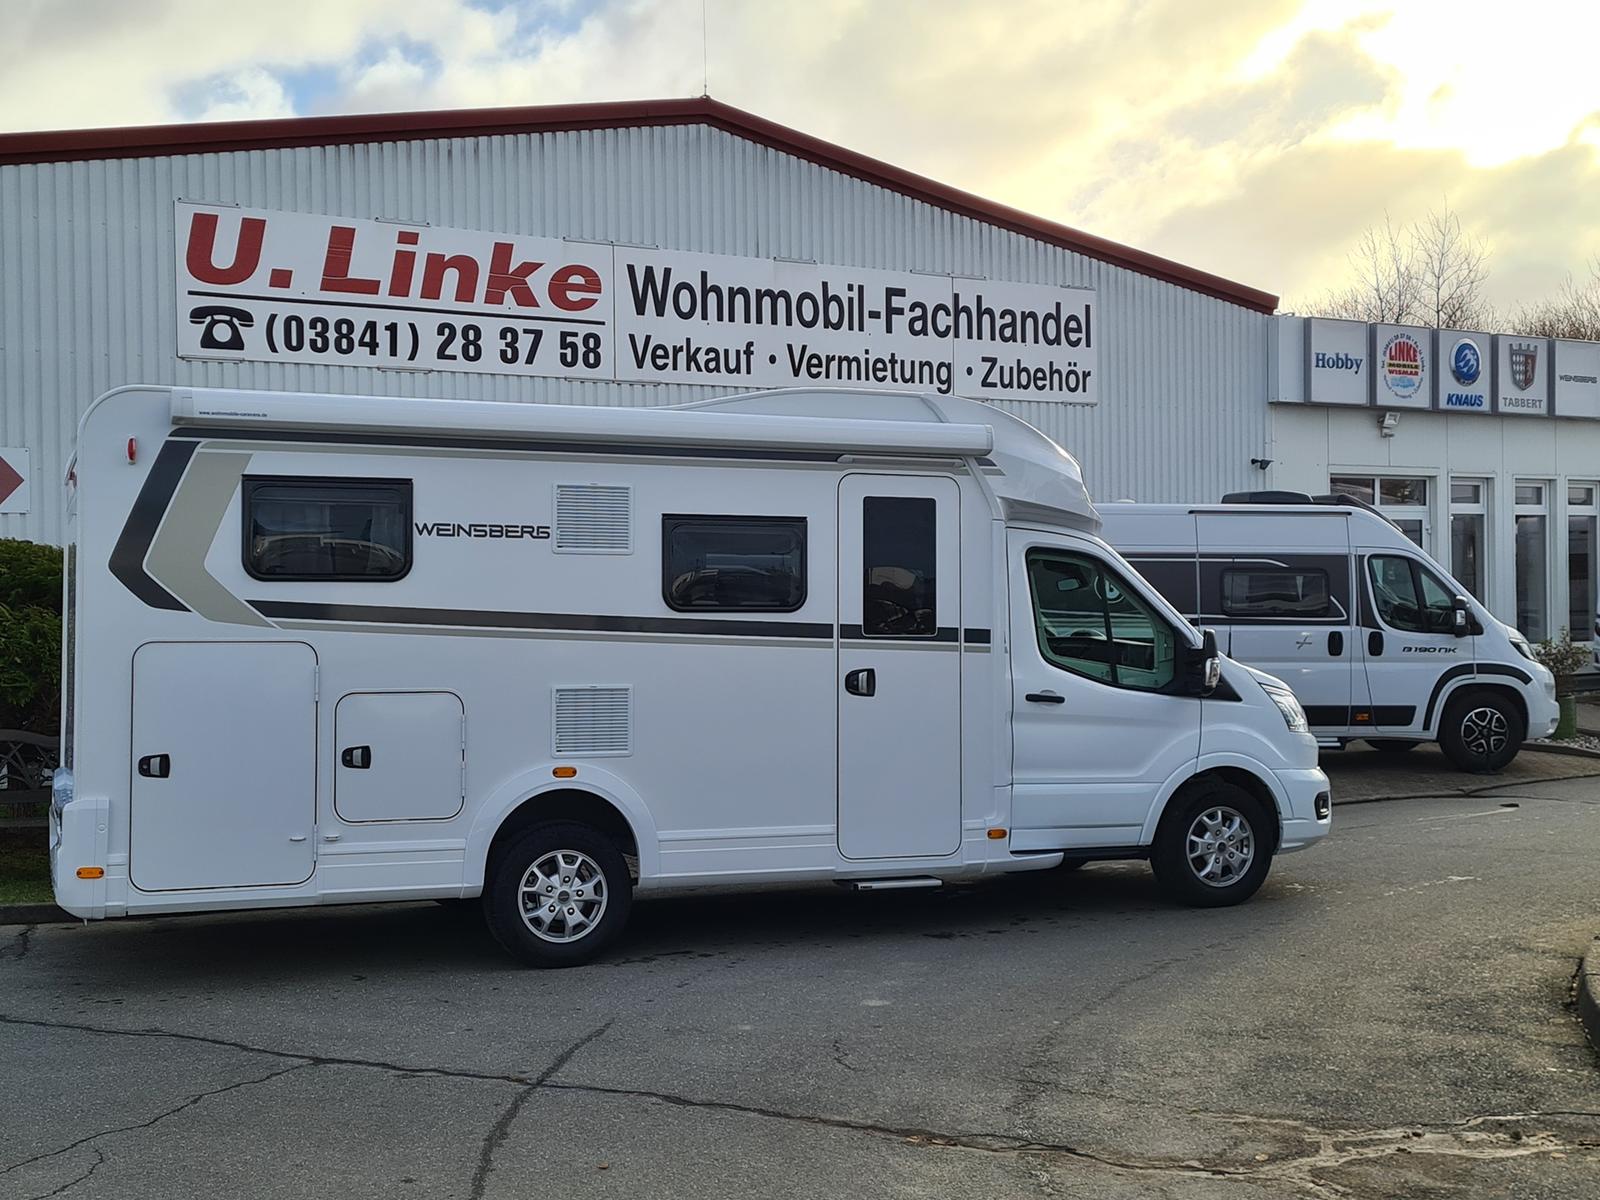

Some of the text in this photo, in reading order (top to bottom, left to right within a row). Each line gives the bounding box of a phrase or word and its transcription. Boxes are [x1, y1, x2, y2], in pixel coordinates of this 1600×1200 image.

[185, 211, 603, 312] U. Linke
[626, 263, 1092, 348] Wohnmobil-Fachhandel
[265, 312, 602, 370] (03841) 28 37 58
[1389, 341, 1418, 362] LINKE
[628, 333, 1092, 395] Verkauf Vermietung Zubehör
[1314, 351, 1363, 374] Hobby
[1387, 362, 1420, 370] MOBILE
[1387, 369, 1419, 377] WISMAR
[1446, 392, 1484, 408] KNAUS
[1502, 396, 1544, 410] TABBERT
[414, 522, 551, 539] WEINSBERG
